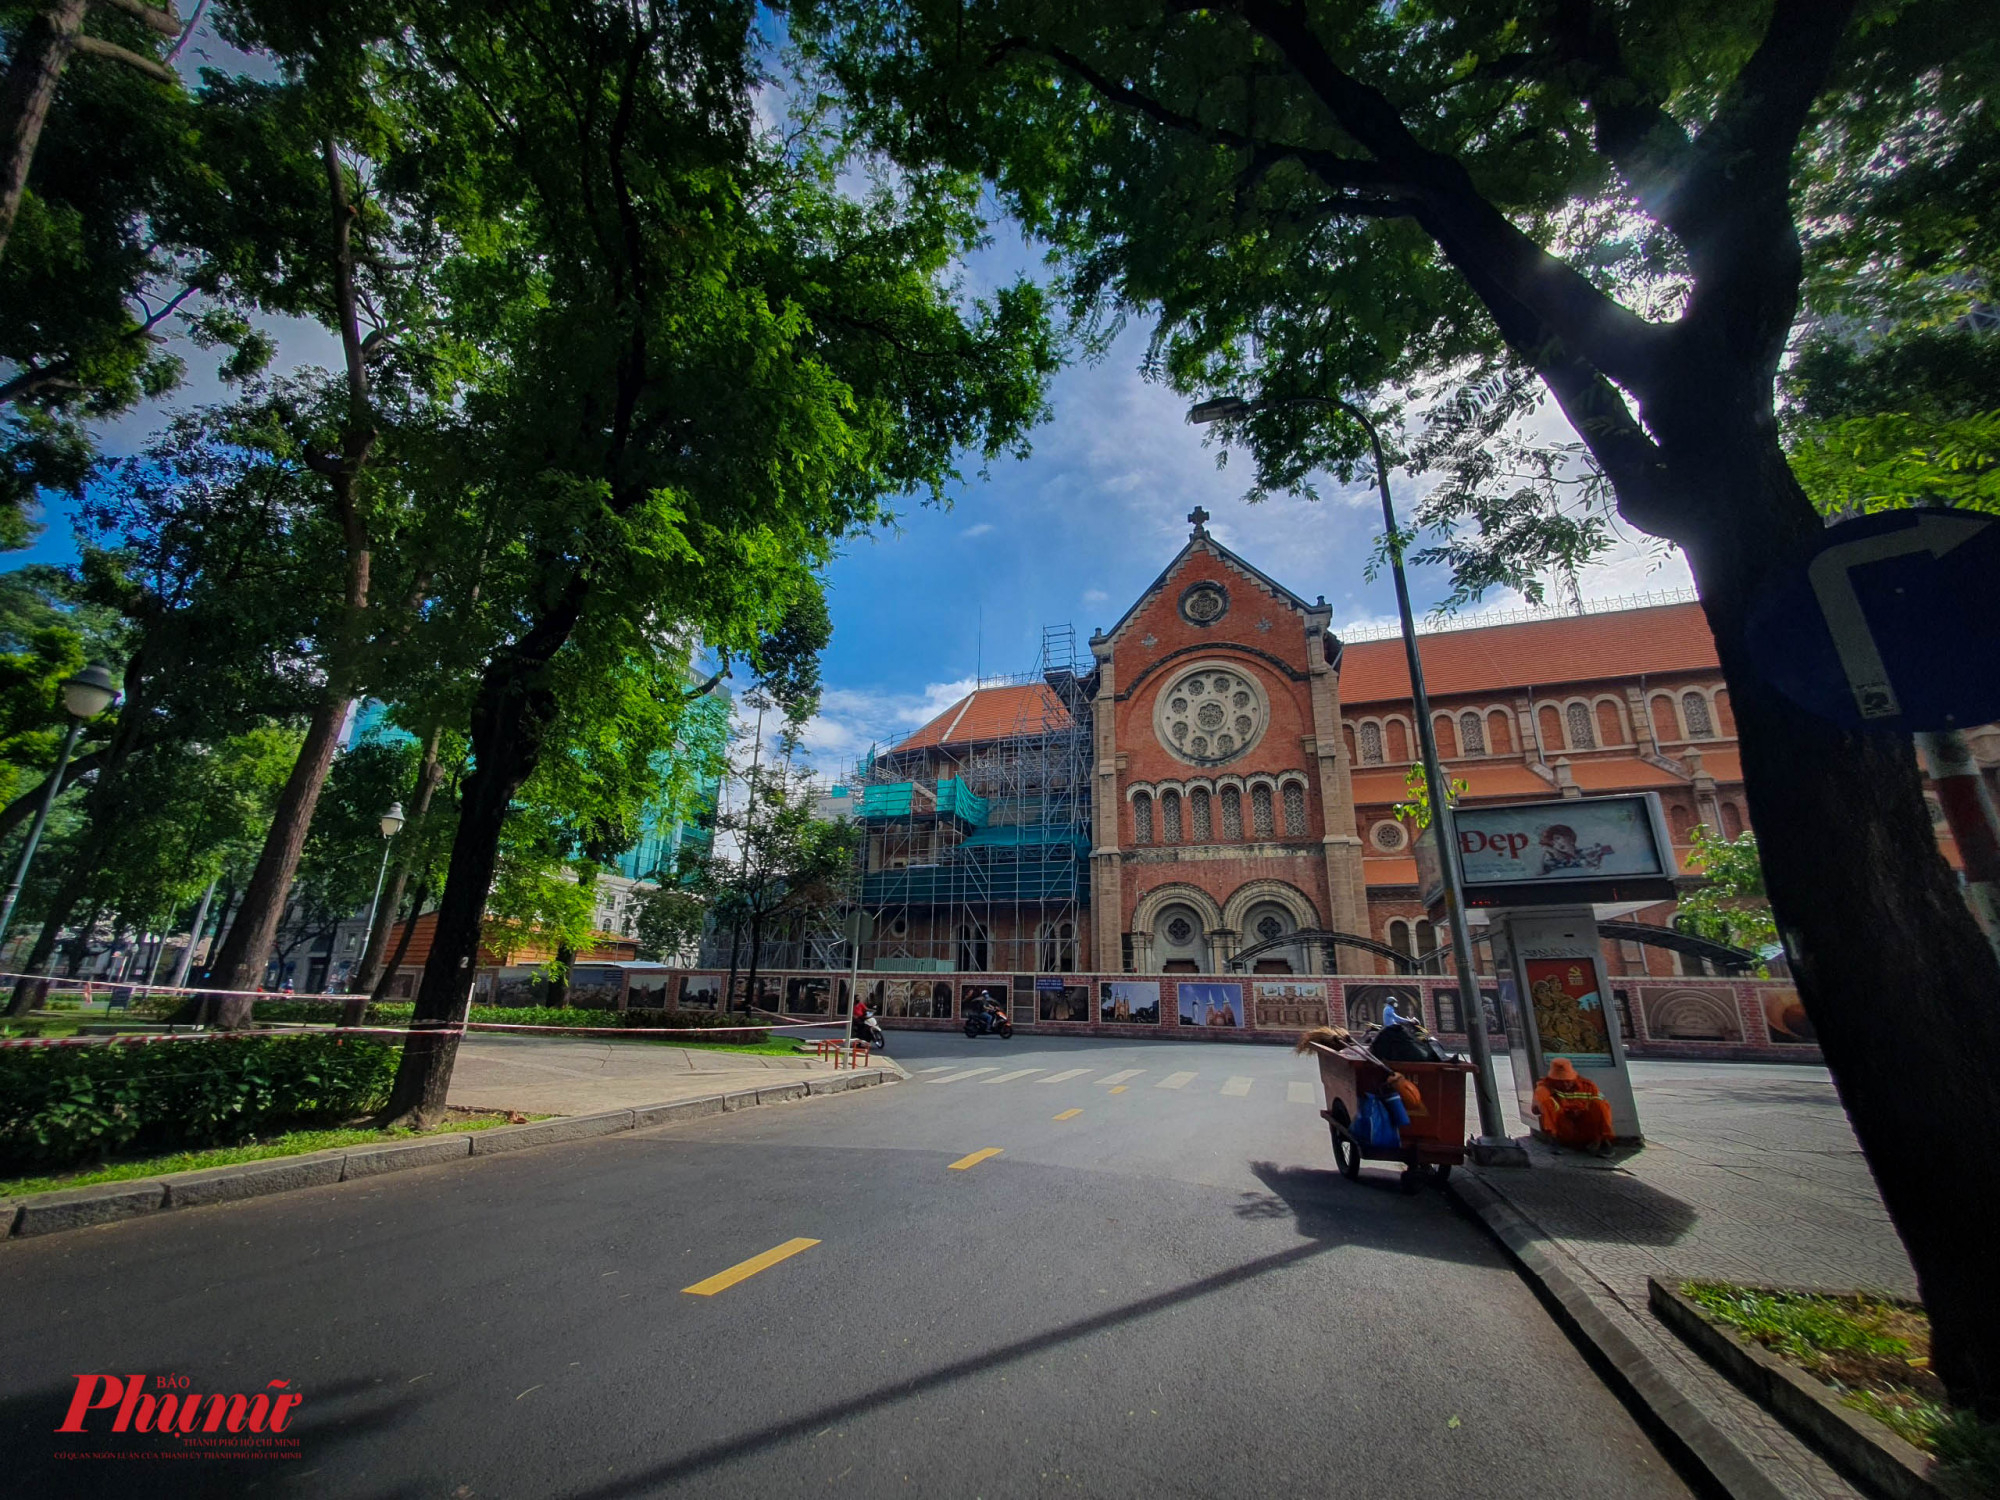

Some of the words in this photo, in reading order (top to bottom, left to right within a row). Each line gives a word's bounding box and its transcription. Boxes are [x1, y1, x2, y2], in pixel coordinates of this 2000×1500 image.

[689, 671, 717, 695] PLAA
[1458, 830, 1529, 859] Đẹp
[460, 956, 469, 969] 2
